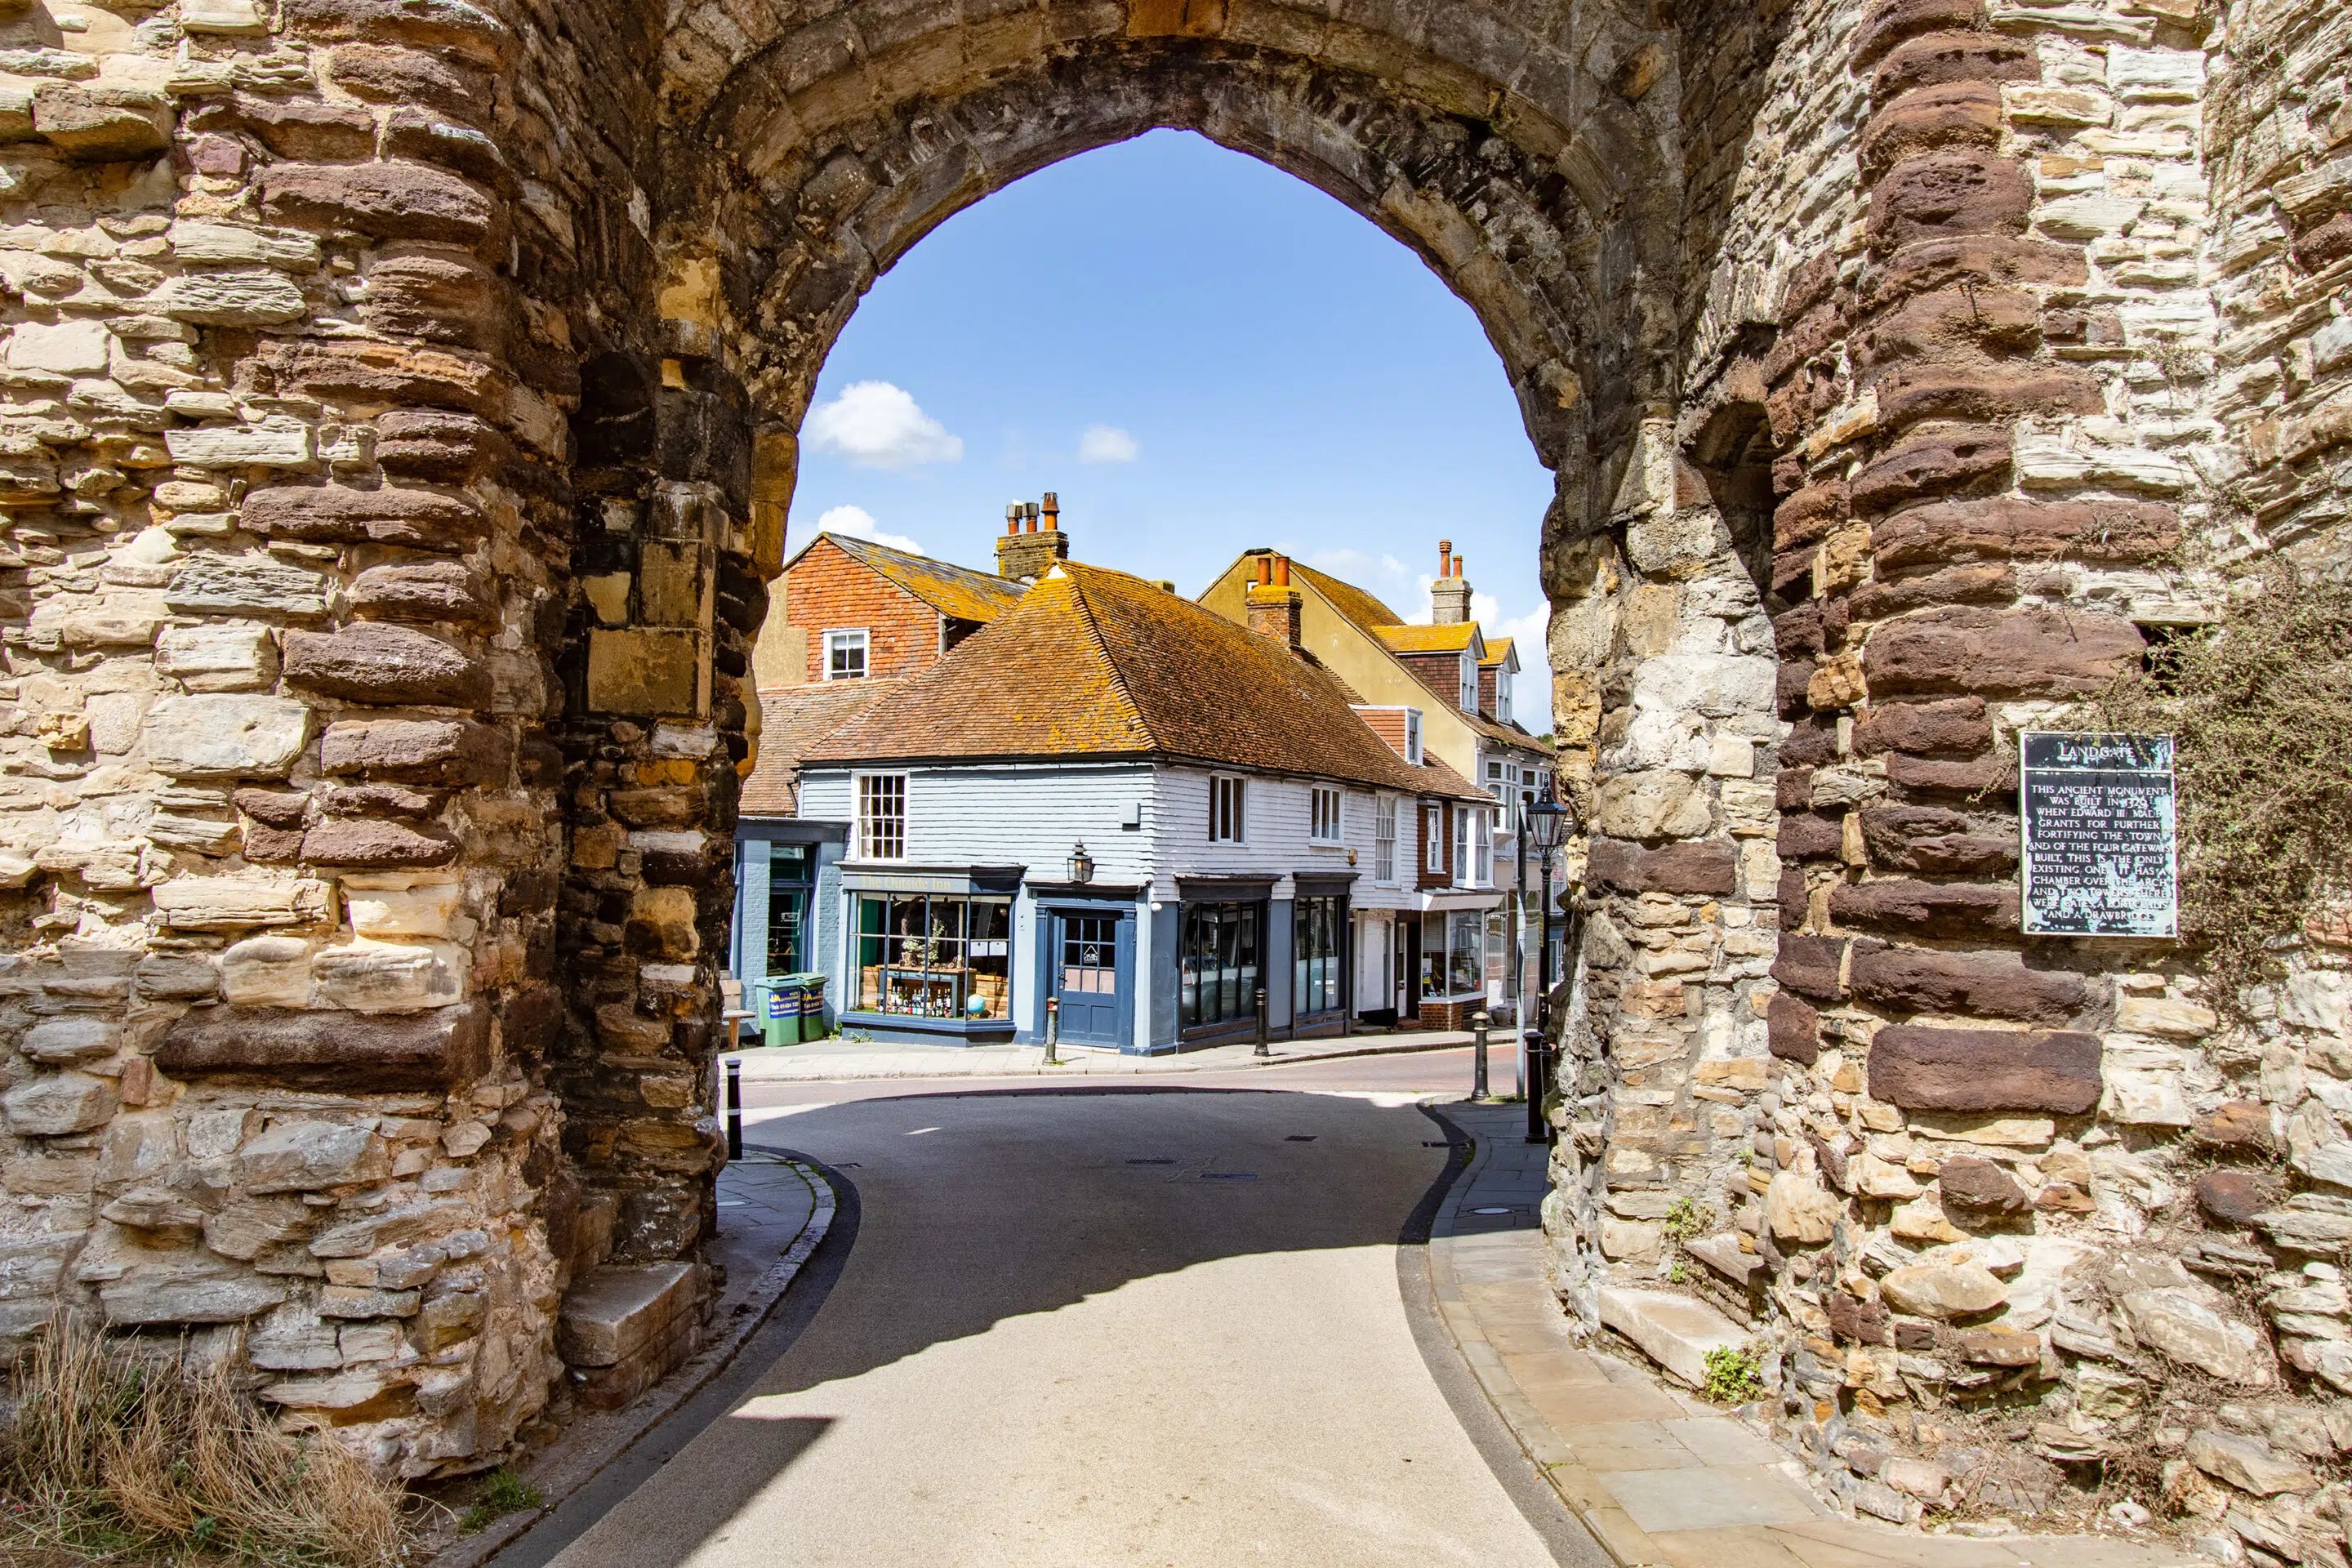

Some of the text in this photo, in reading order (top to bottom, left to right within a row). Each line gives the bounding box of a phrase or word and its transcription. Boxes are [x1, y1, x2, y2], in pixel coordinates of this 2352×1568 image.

[2060, 743, 2136, 759] LANDGATE
[2031, 785, 2167, 795] THIS ANCIENT MONUMENT
[2050, 796, 2148, 809] WAS BUILT IN 1329
[2036, 808, 2161, 818] WHEN EDWARD III MADE
[2038, 819, 2160, 830] GRANTS FOR FURTHER
[2038, 831, 2163, 841] FORTIFYING THE TOWN
[2028, 842, 2171, 853] AND OF THE FOUR GATEWAYS
[2034, 853, 2164, 864] BUILT, THIS IS THE ONLY
[2032, 865, 2080, 874] EXISTING
[2118, 866, 2129, 875] IT
[2135, 866, 2154, 875] HAS
[2158, 867, 2167, 875] A
[862, 875, 951, 890] The Outside Inn
[2032, 876, 2167, 888] CHAMBER OVER THE ARCH
[2033, 888, 2056, 896] AND
[2060, 888, 2082, 897] TWO
[2034, 898, 2060, 907] WERE
[2047, 911, 2071, 919] AND
[2074, 911, 2082, 919] A
